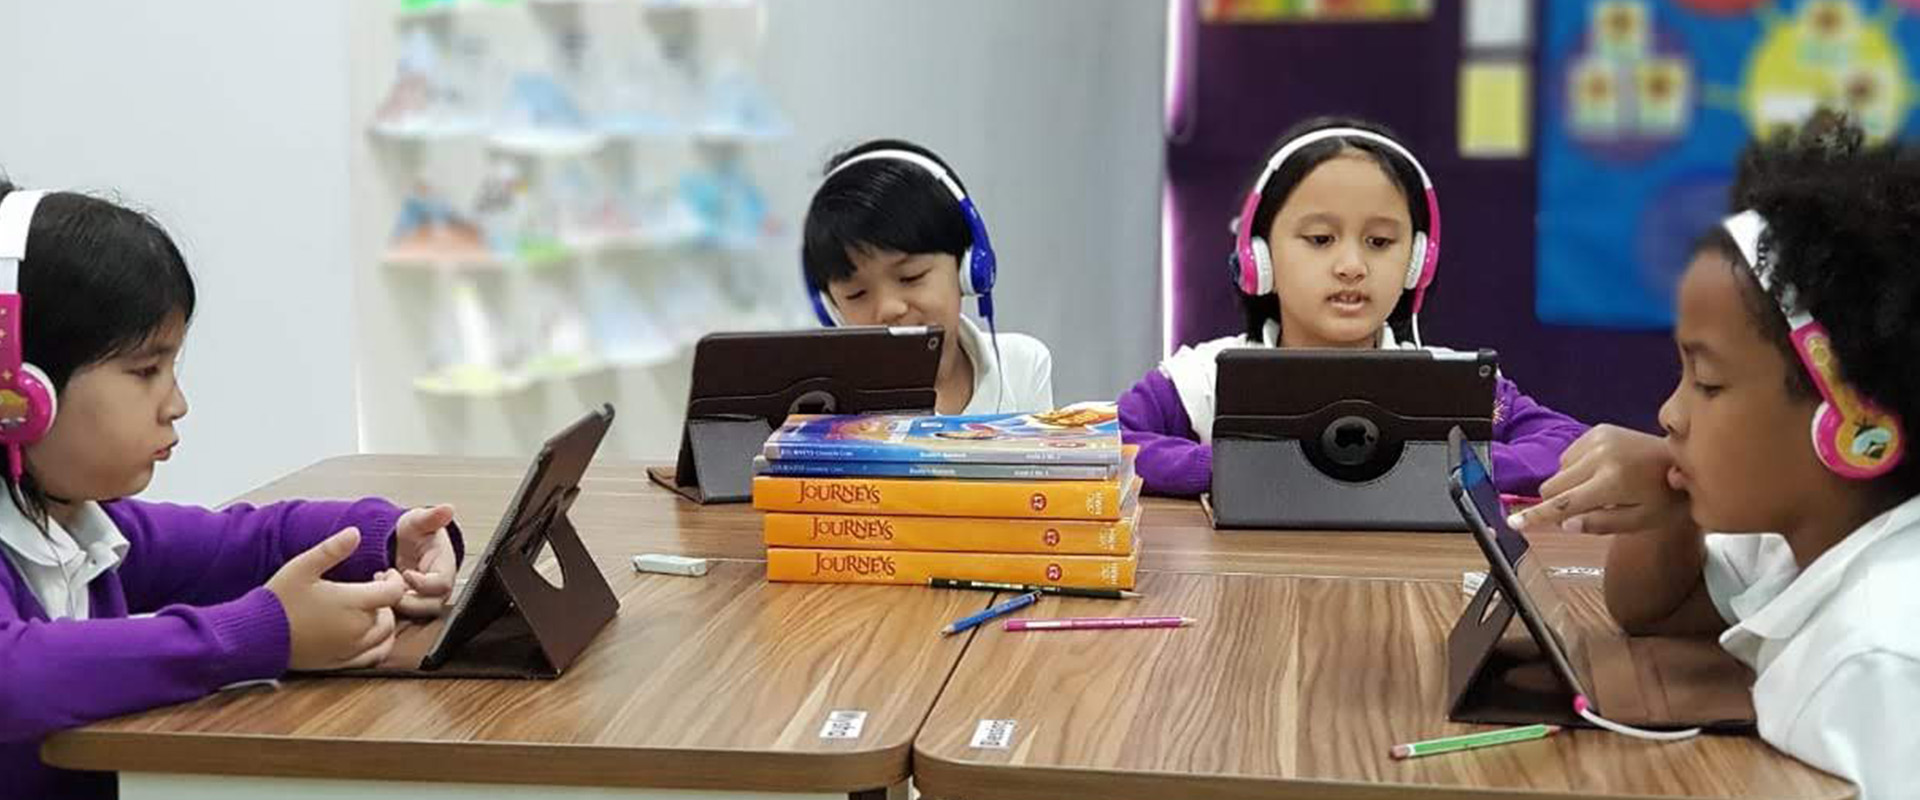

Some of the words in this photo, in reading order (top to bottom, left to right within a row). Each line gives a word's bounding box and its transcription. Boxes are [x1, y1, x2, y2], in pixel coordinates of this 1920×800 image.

[796, 481, 880, 504] JOURNEYS
[810, 516, 893, 540] JOURNEYS
[811, 553, 896, 576] JOURNEYS
